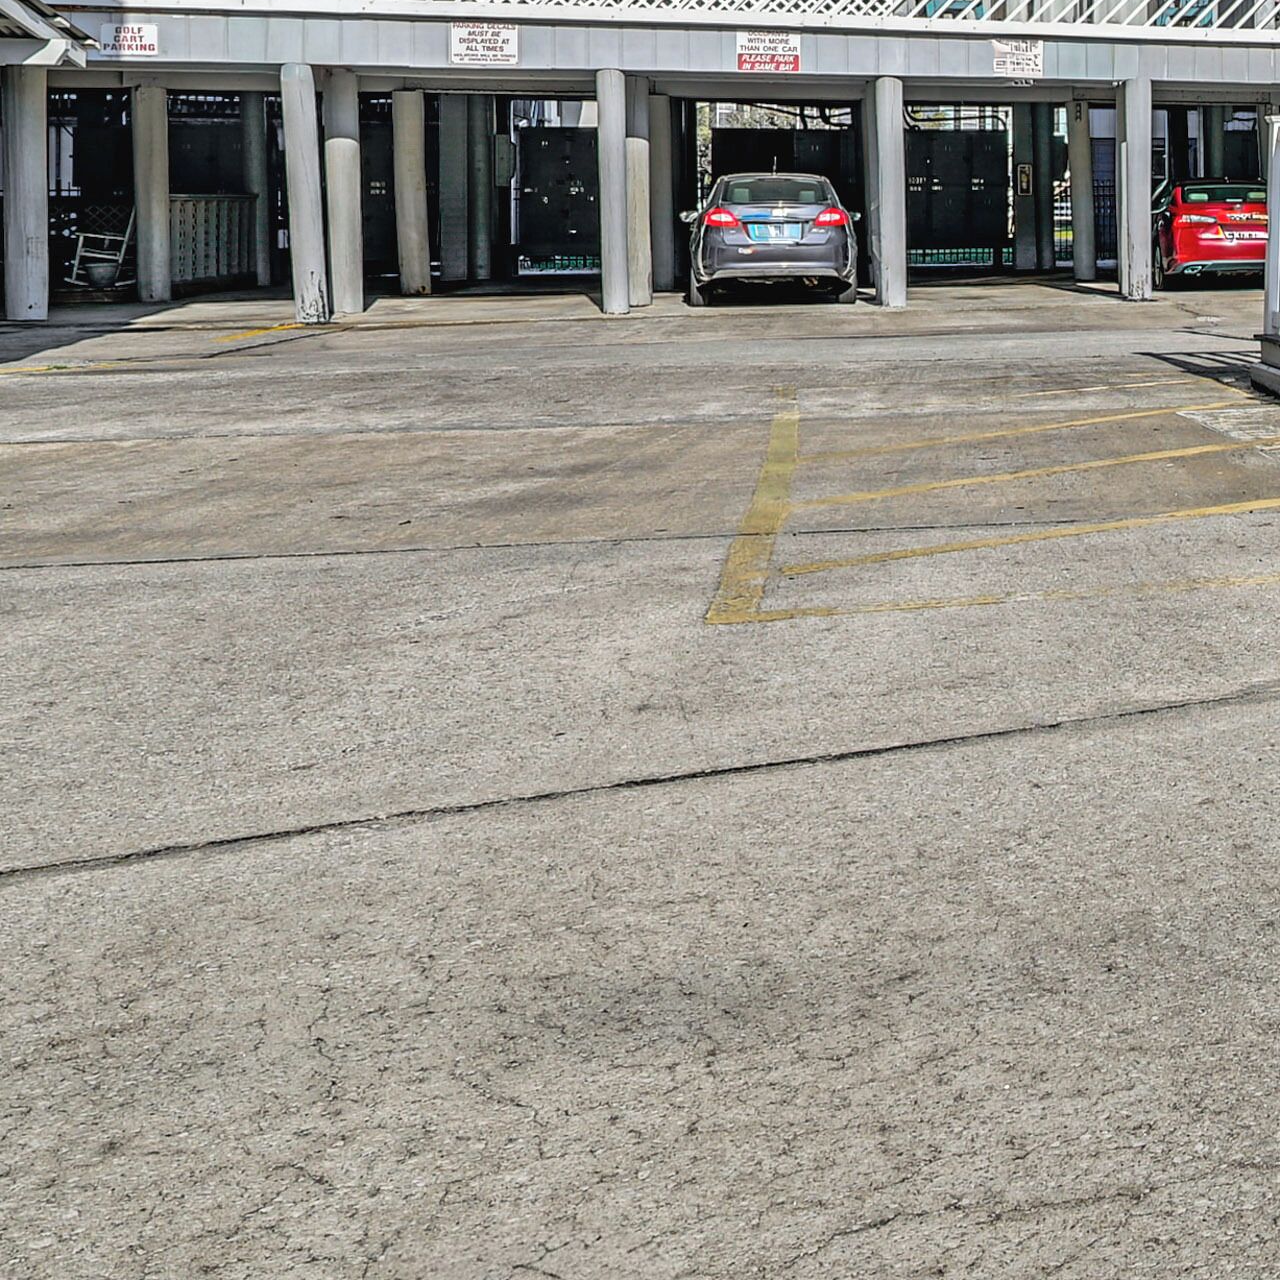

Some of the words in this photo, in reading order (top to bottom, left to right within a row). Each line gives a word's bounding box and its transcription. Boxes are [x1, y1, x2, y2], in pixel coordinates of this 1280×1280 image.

[115, 26, 143, 34] GOLF
[113, 35, 145, 43] CART
[103, 43, 156, 51] PARKING
[482, 45, 505, 53] TIMES
[742, 54, 772, 62] PLEASE
[774, 55, 795, 63] PARK
[754, 63, 777, 71] SAME
[779, 63, 795, 71] BAY
